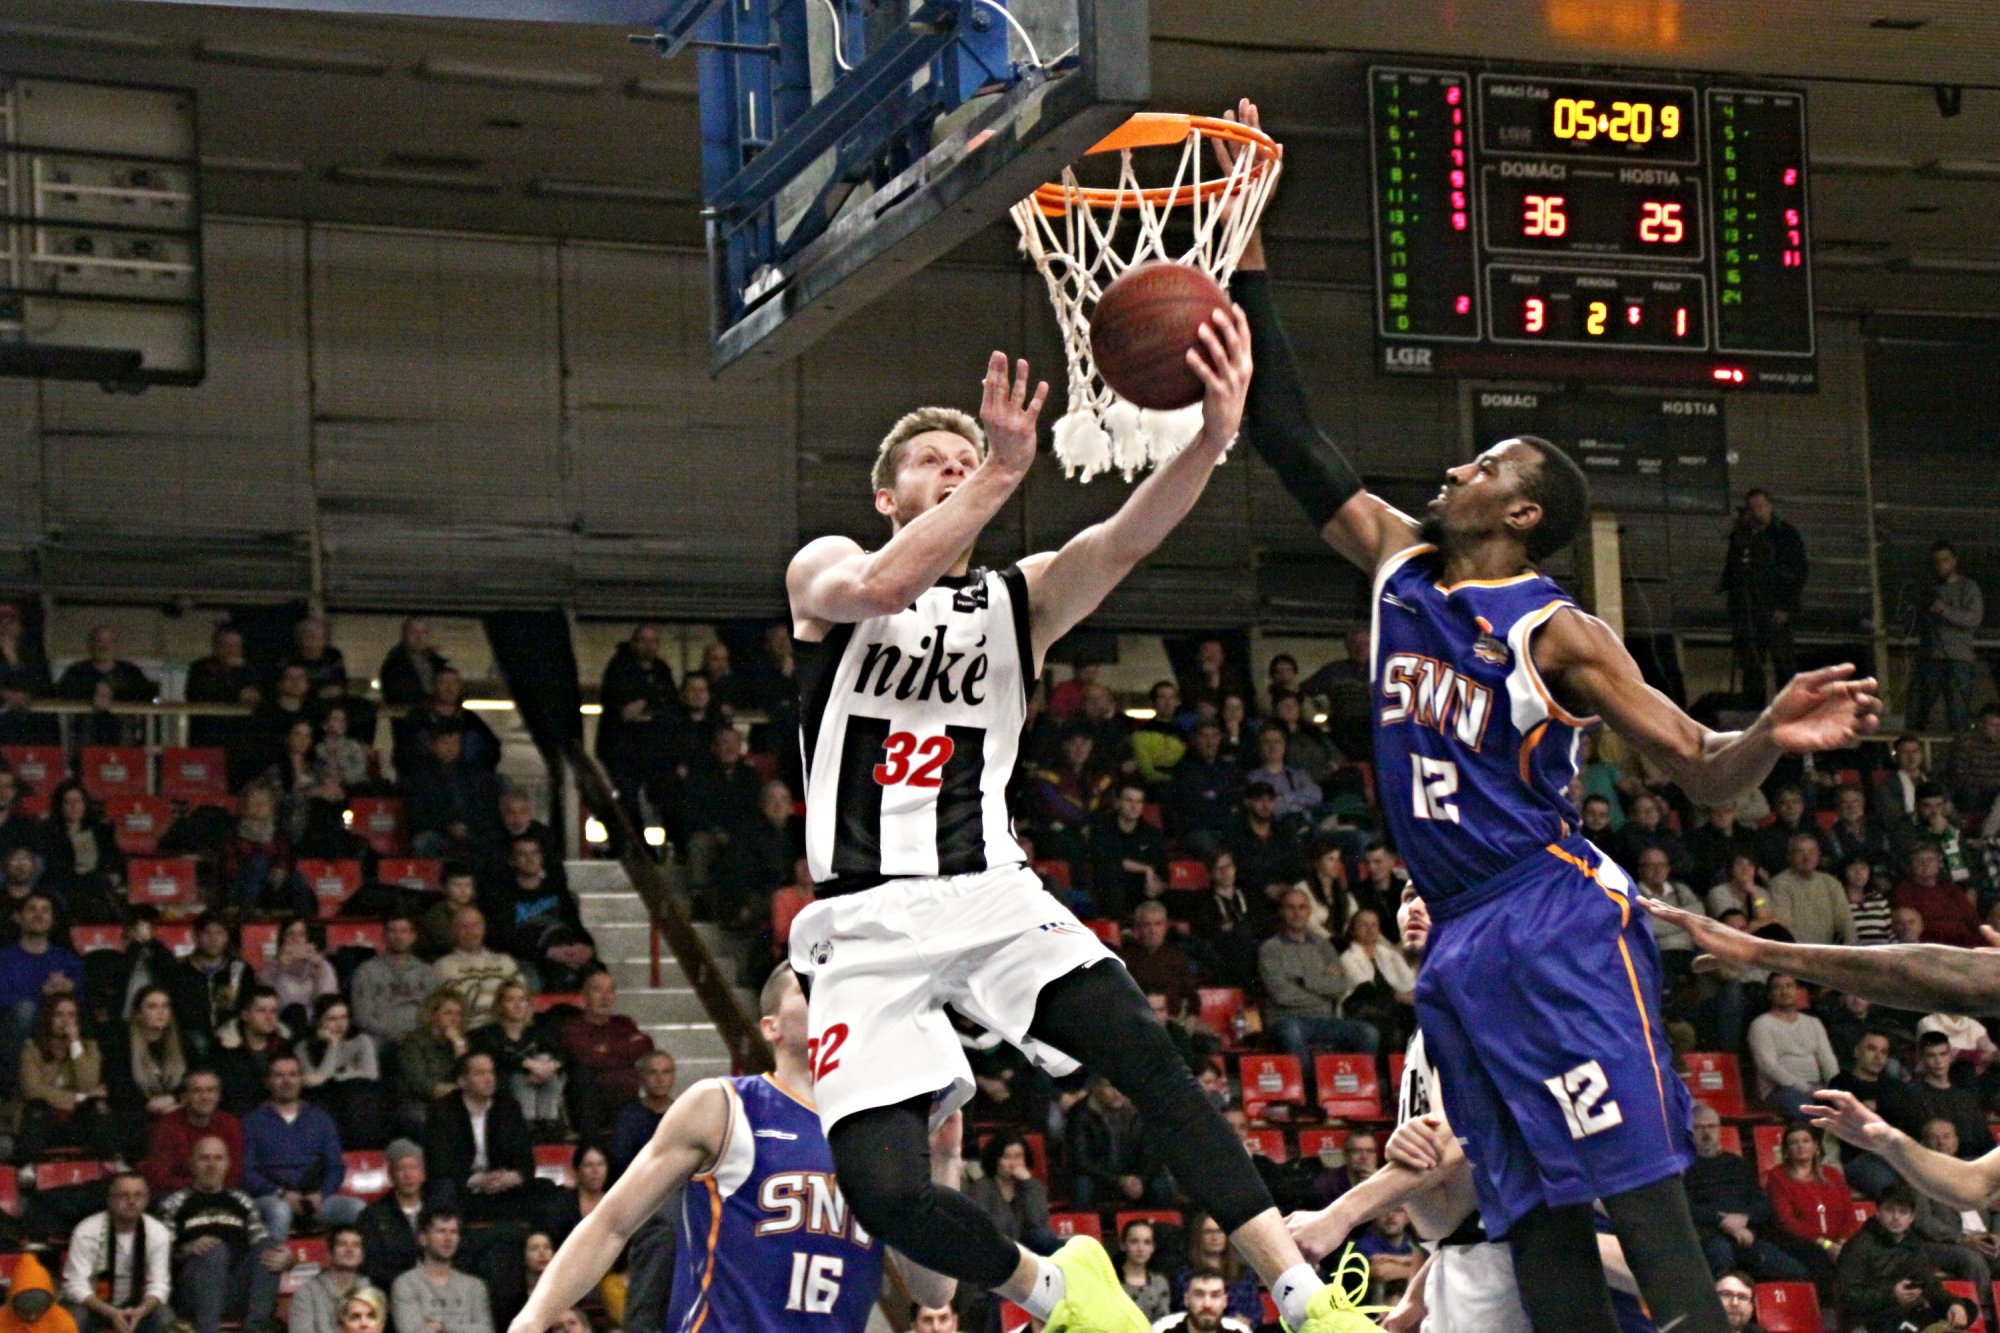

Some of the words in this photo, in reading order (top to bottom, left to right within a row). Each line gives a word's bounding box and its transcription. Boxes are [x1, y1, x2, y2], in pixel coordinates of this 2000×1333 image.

[1453, 108, 1462, 125] 1
[1454, 129, 1463, 147] 1
[1450, 148, 1465, 167] 7
[1500, 161, 1567, 179] DOMÁCI
[1620, 168, 1680, 185] HOSTIA
[1523, 194, 1567, 238] 36
[1639, 201, 1685, 244] 25
[1787, 229, 1801, 247] 7
[1783, 249, 1801, 267] 11
[1524, 297, 1545, 333] 3
[1587, 301, 1608, 335] 2
[1675, 307, 1687, 337] 1
[1385, 347, 1432, 366] LGR
[1662, 401, 1718, 416] HOSTIA
[854, 624, 989, 707] niké
[872, 730, 955, 789] 32
[1410, 752, 1460, 825] 12
[1543, 1059, 1624, 1141] 12
[755, 1172, 873, 1250] SN
[785, 1251, 844, 1315] 16
